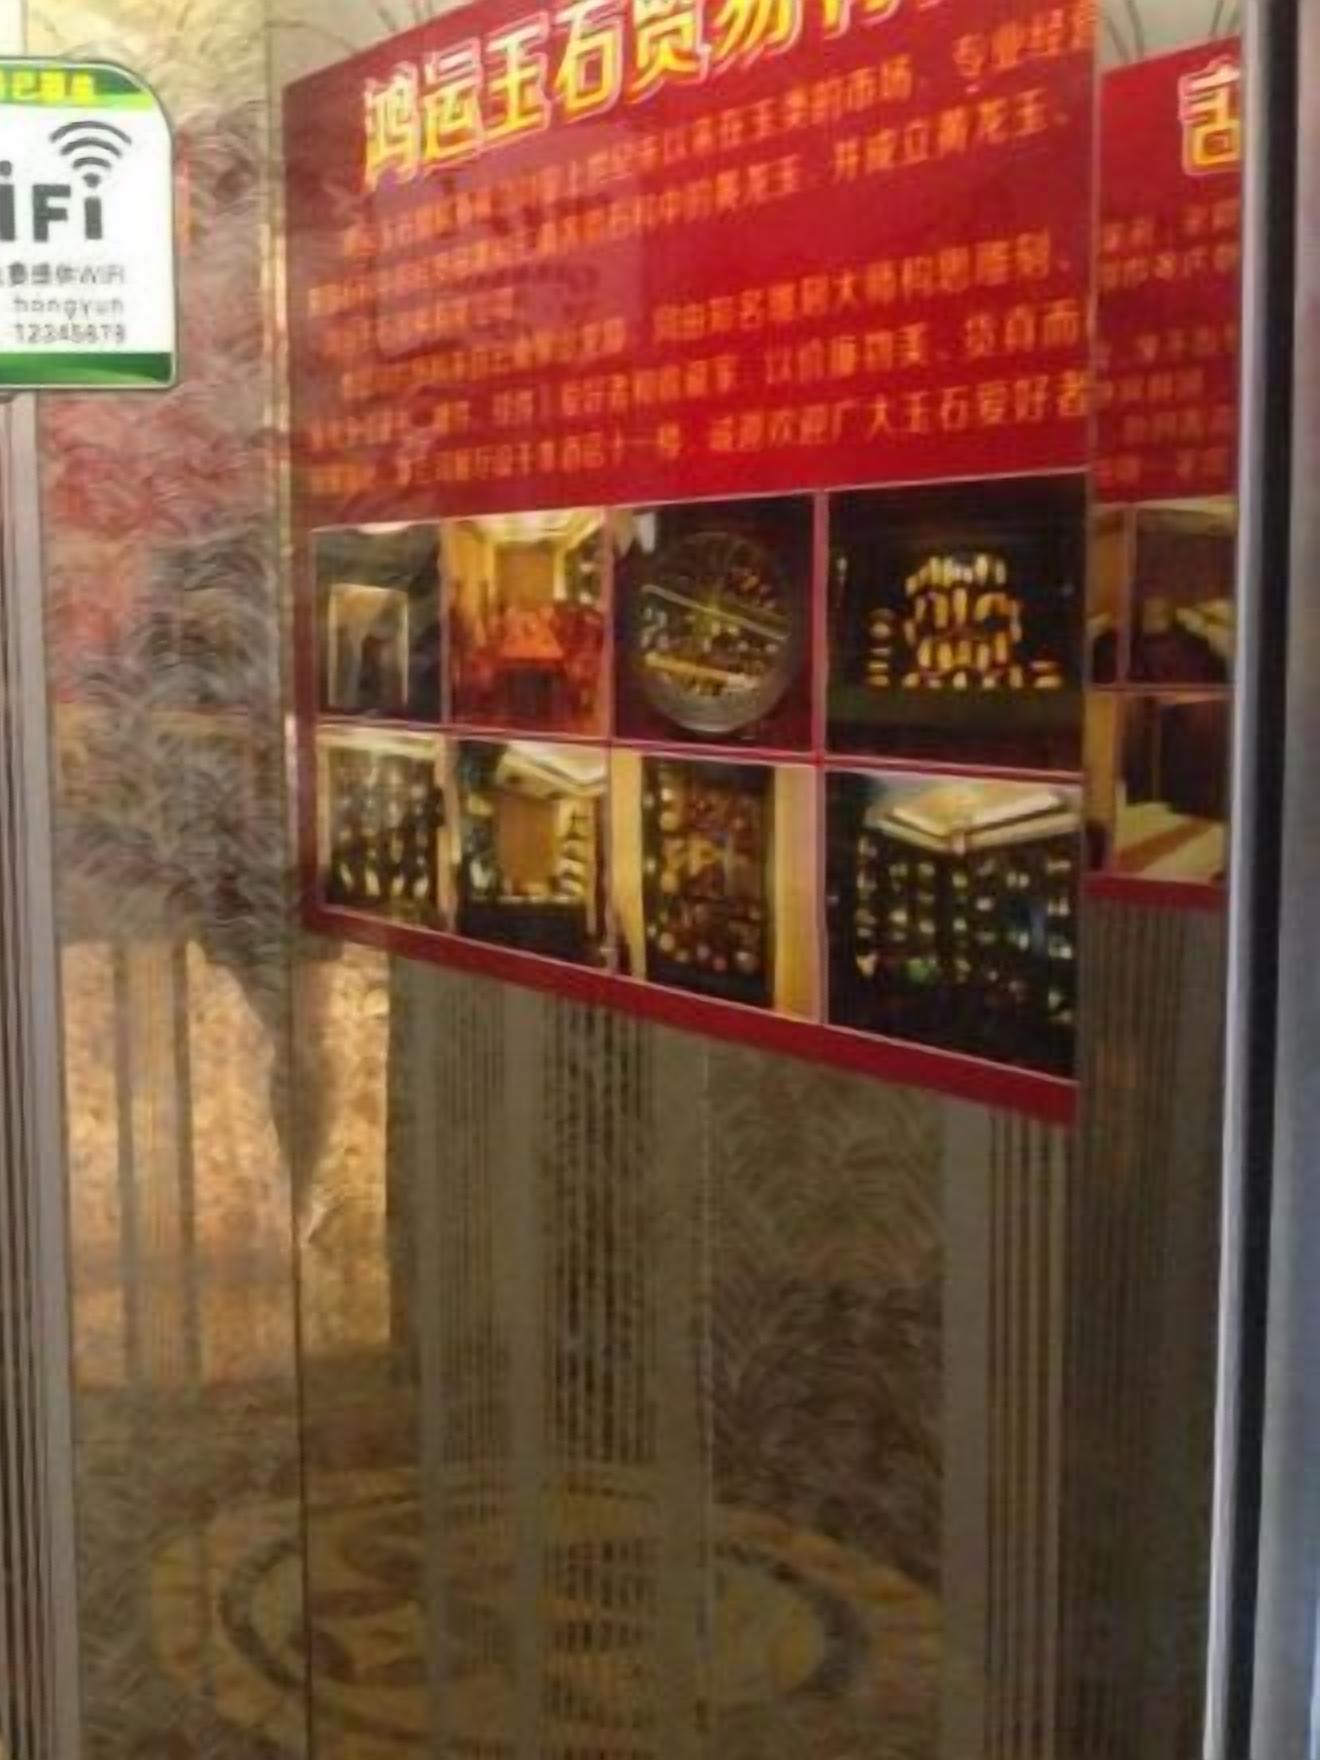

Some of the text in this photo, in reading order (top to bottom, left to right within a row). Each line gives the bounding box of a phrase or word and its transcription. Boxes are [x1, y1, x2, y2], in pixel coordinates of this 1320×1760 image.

[362, 0, 948, 195] 鸿运玉石贸易
